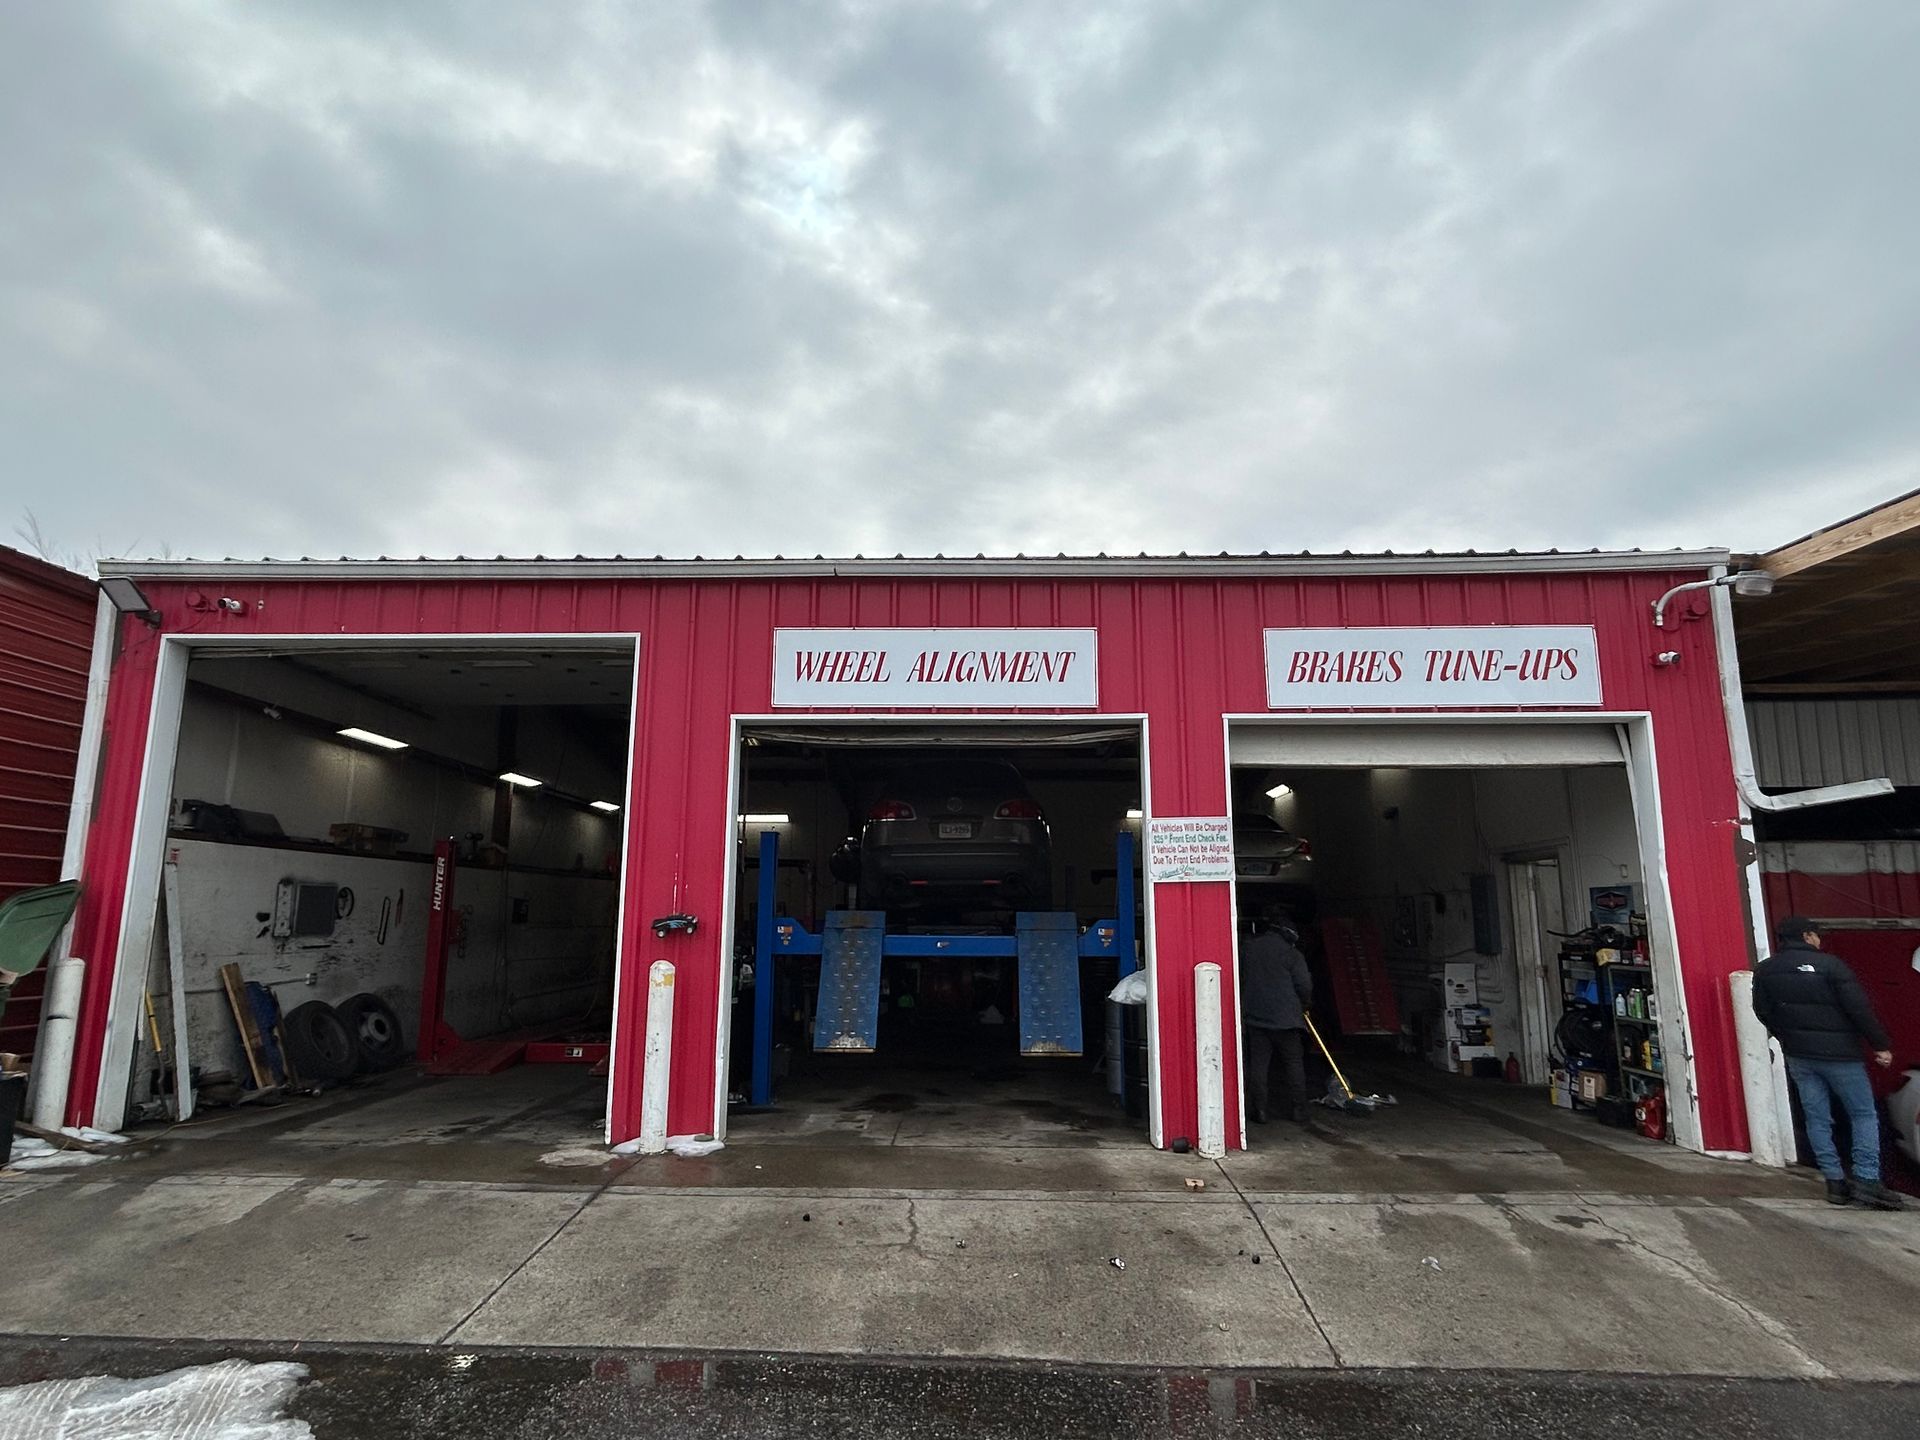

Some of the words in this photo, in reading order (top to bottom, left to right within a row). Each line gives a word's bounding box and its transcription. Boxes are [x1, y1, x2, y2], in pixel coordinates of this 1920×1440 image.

[795, 651, 892, 683] WHEEL
[906, 651, 1077, 683] ALIGNMENT
[1286, 650, 1404, 683] BRAKES
[1424, 648, 1578, 682] TUNE-UPS
[1160, 823, 1183, 832] Vehicles
[1184, 823, 1194, 832] Will
[1196, 823, 1203, 832] Be
[1204, 823, 1228, 834] Charged
[1169, 833, 1184, 843] Front
[1185, 834, 1196, 843] End
[1198, 834, 1214, 843] Check
[1157, 845, 1176, 854] Vehicle
[1177, 845, 1188, 854] Can
[1190, 844, 1199, 853] Not
[1209, 844, 1230, 855] Aligned
[1153, 856, 1164, 865] Due
[1165, 856, 1172, 865] To
[1173, 855, 1188, 865] Front
[1190, 855, 1201, 864] End
[432, 856, 446, 911] HUNTER
